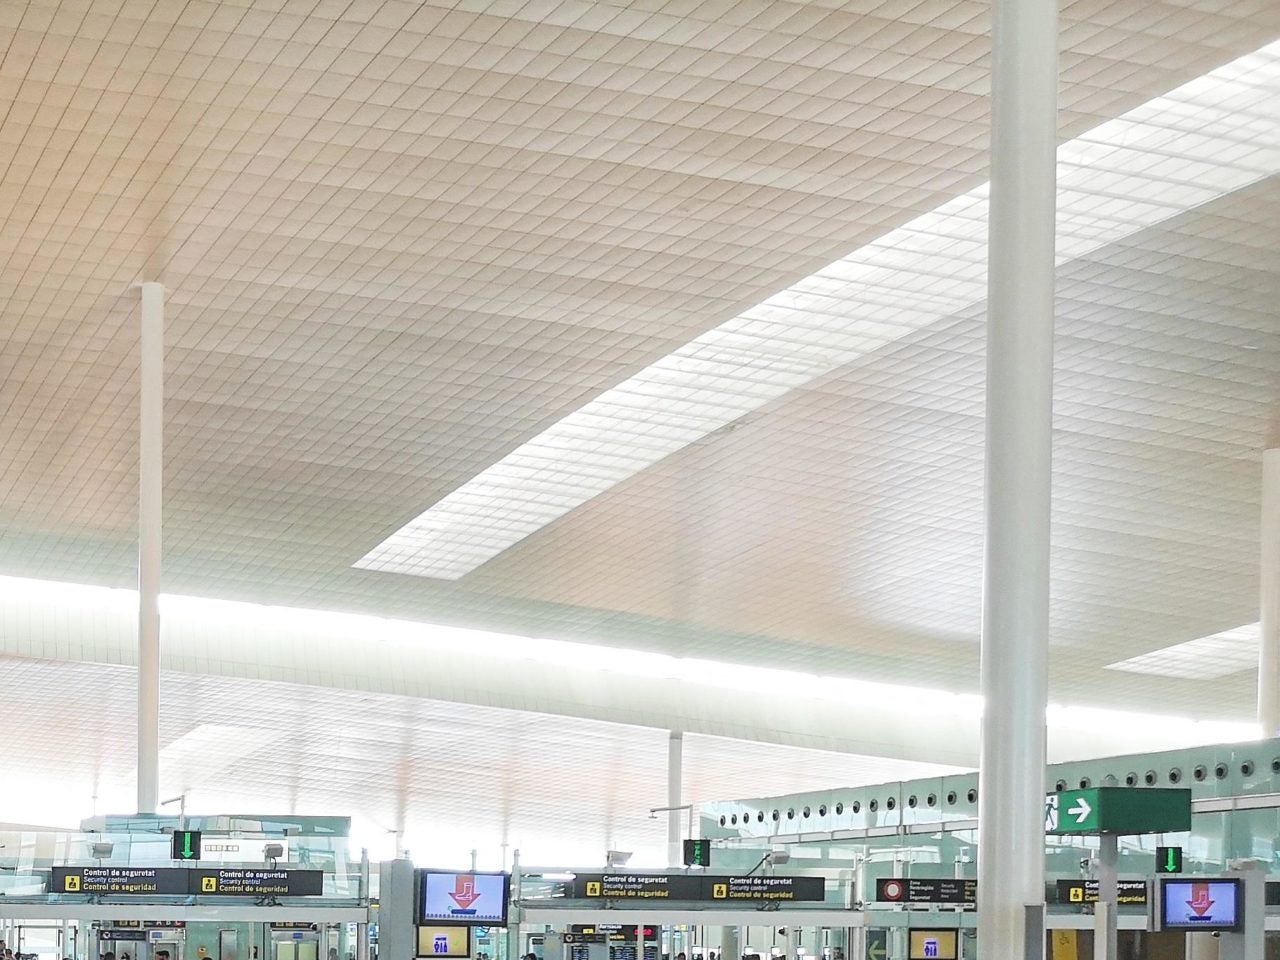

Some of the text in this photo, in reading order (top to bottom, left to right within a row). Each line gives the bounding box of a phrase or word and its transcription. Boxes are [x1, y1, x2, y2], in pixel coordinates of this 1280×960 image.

[83, 869, 155, 877] Control de seguretat
[256, 872, 288, 880] seguretat
[122, 884, 157, 892] seguridad
[256, 886, 289, 894] seguridad
